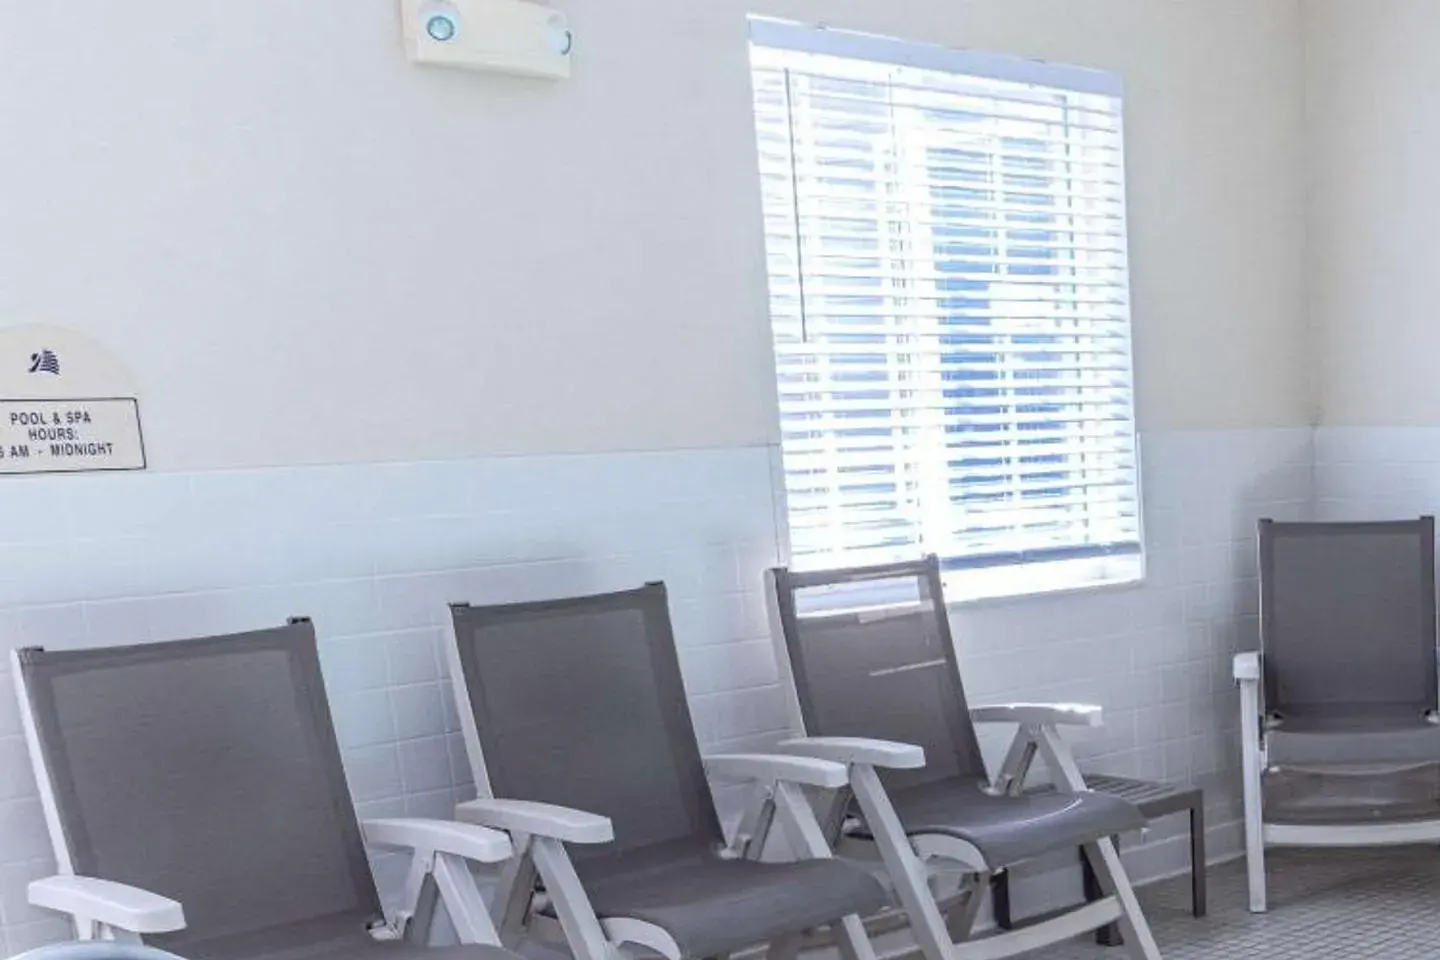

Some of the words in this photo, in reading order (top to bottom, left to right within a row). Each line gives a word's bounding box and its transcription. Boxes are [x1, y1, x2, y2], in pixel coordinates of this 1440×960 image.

[10, 411, 48, 425] POOL
[53, 411, 61, 424] &
[65, 411, 92, 424] SPA
[28, 427, 80, 441] HOURS:
[10, 444, 29, 457] AM
[50, 442, 113, 456] MIDNIGHT
